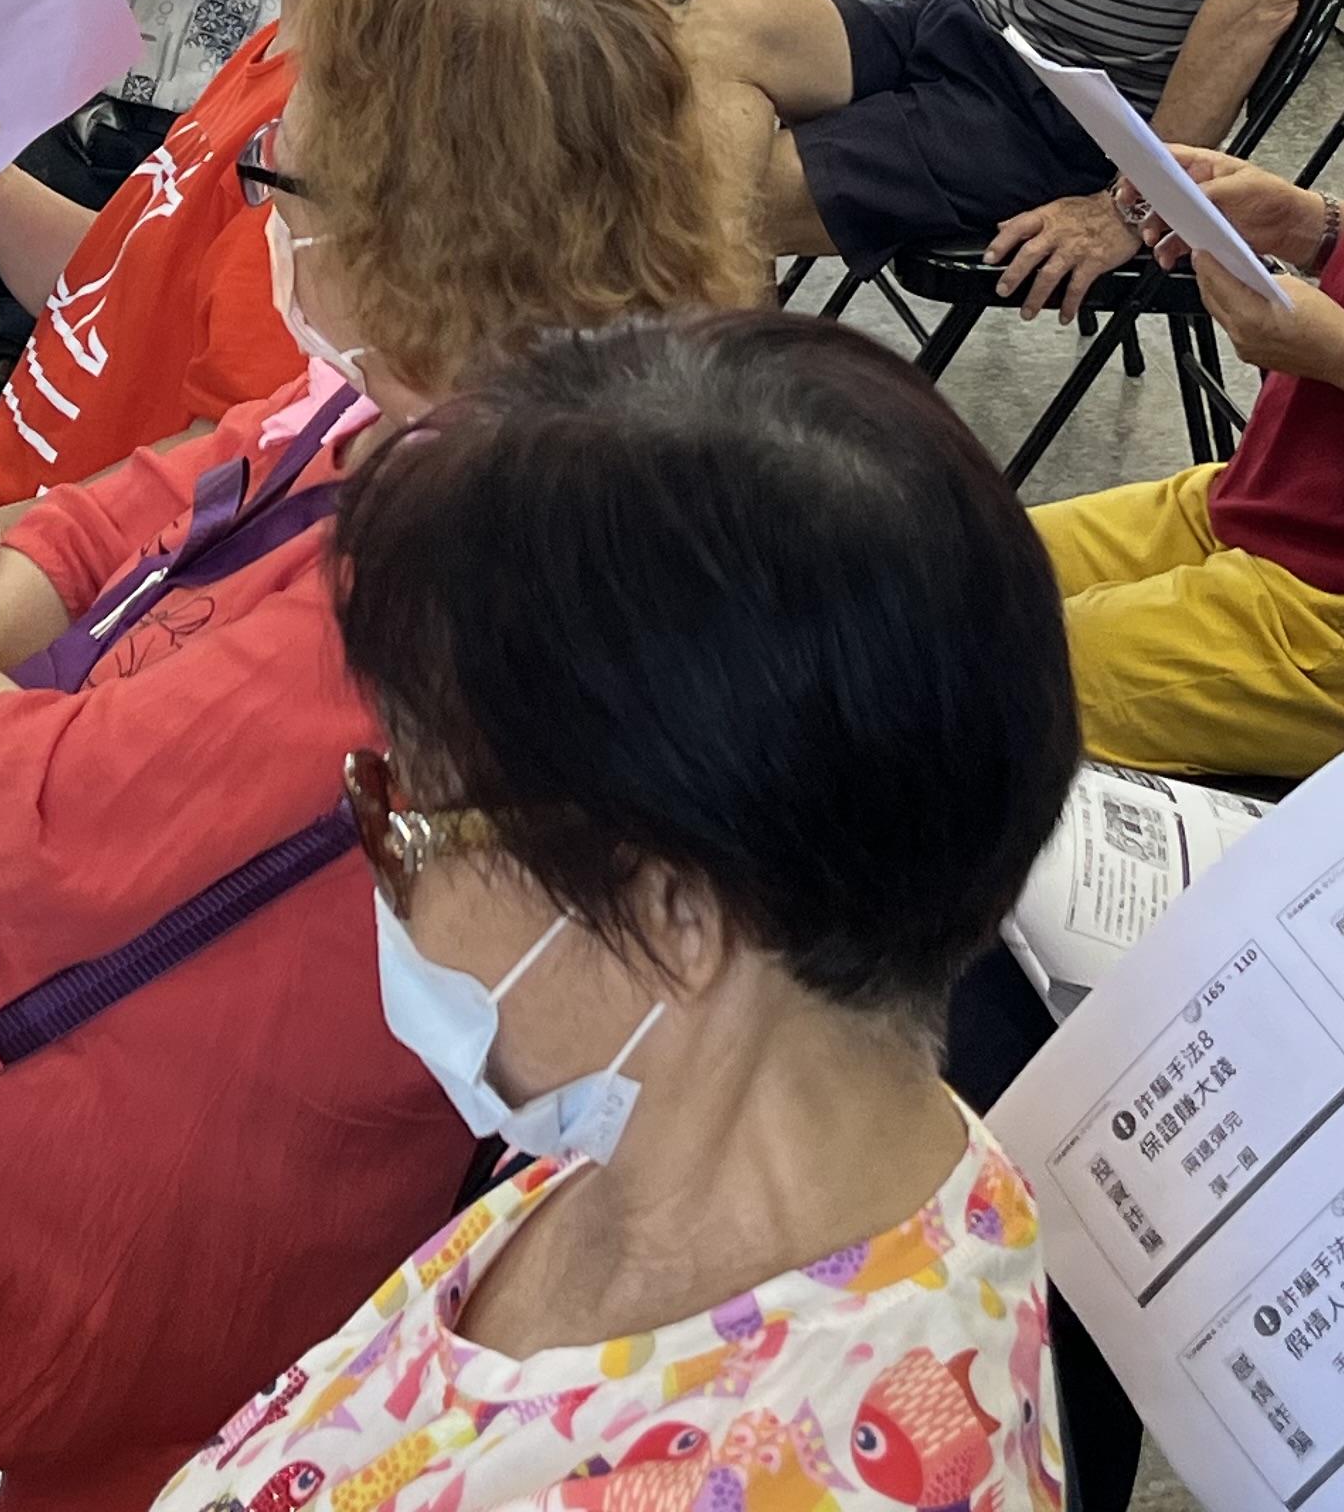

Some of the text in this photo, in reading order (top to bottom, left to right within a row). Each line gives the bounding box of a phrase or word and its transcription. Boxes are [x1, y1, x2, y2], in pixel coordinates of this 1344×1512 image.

[1133, 1029, 1215, 1120] 詐騙手法8
[1138, 1056, 1237, 1162] 保證賺大錢
